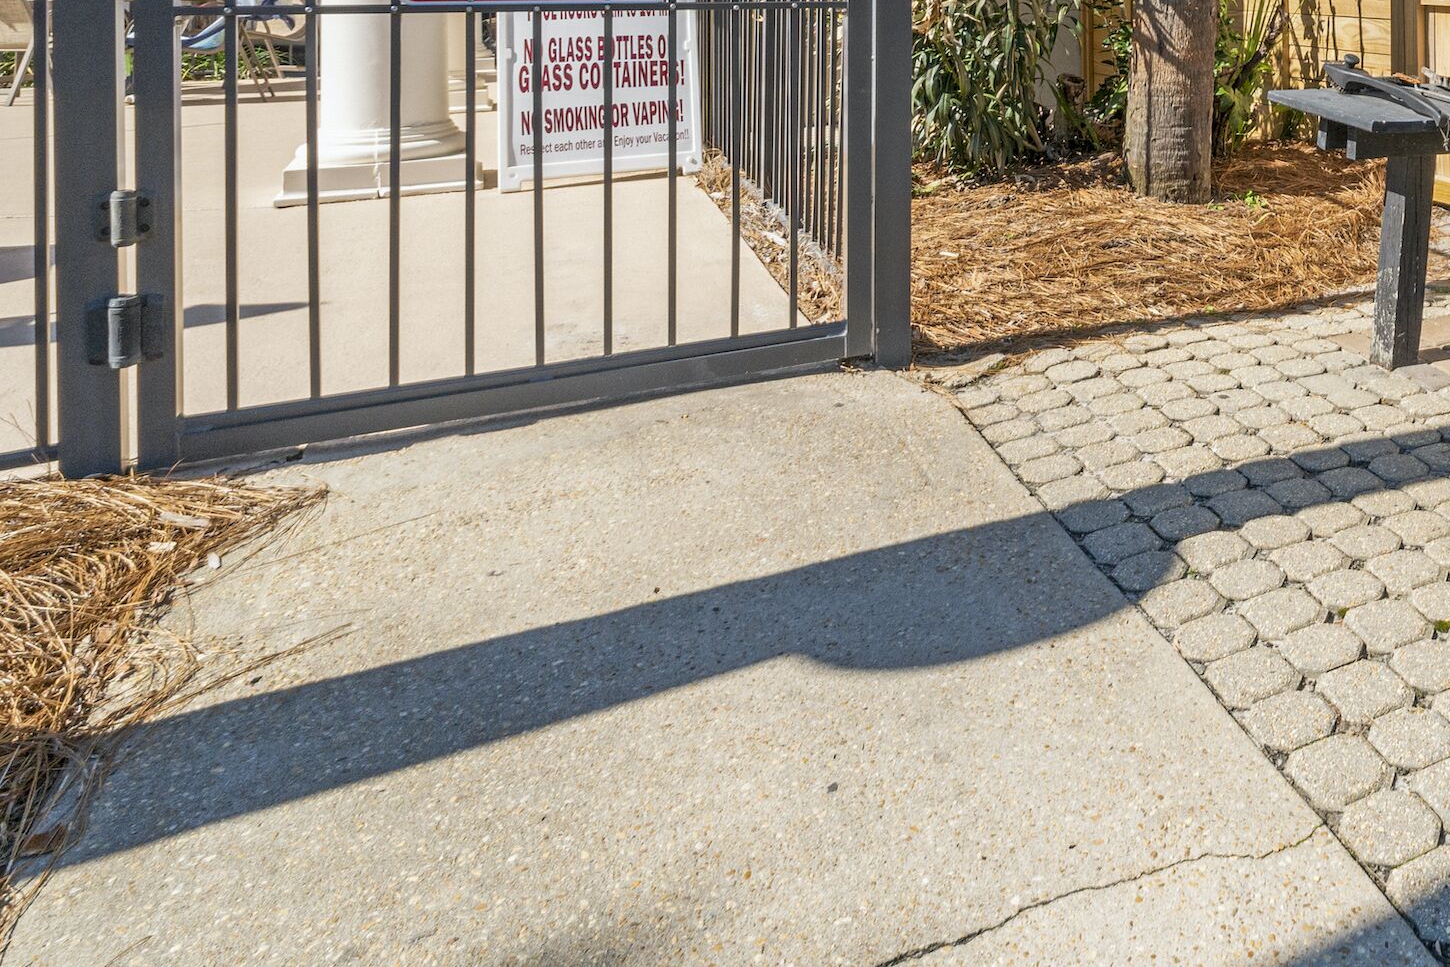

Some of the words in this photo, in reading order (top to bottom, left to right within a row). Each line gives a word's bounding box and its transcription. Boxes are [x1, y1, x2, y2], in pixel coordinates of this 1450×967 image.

[524, 38, 543, 64] N
[548, 36, 593, 63] GLASS
[598, 34, 653, 61] BTTLES
[518, 65, 573, 94] GASS
[579, 59, 685, 91] COTAINER!
[611, 101, 629, 128] OR
[520, 142, 553, 156] Resect
[554, 139, 574, 153] each
[575, 138, 596, 151] other
[614, 135, 634, 150] Enjoy
[635, 135, 652, 147] your
